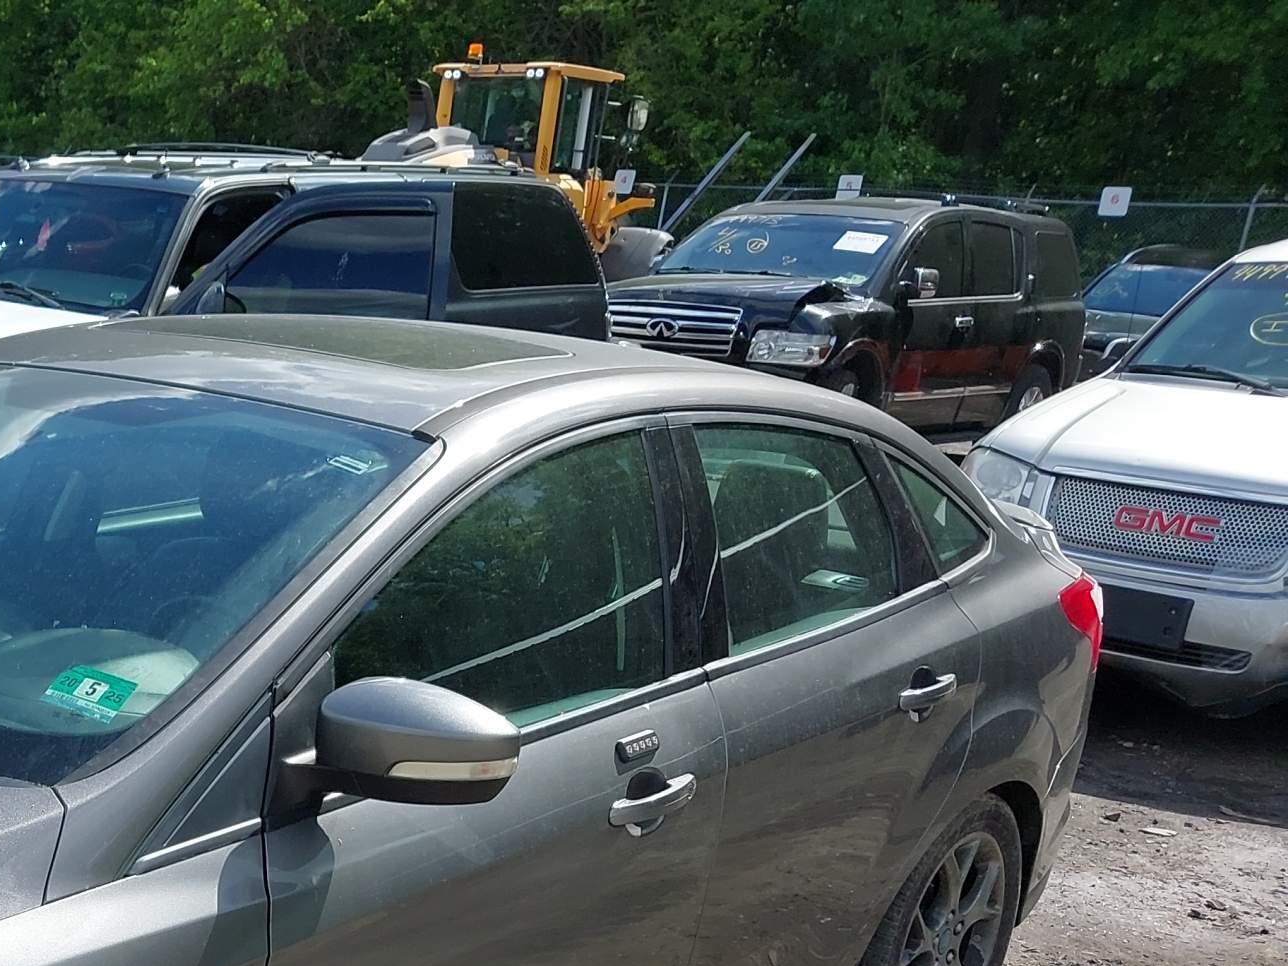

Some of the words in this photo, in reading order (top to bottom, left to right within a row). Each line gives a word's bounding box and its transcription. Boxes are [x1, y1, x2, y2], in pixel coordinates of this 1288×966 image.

[1113, 504, 1224, 544] GMC
[85, 682, 102, 696] 5
[104, 691, 124, 704] 25
